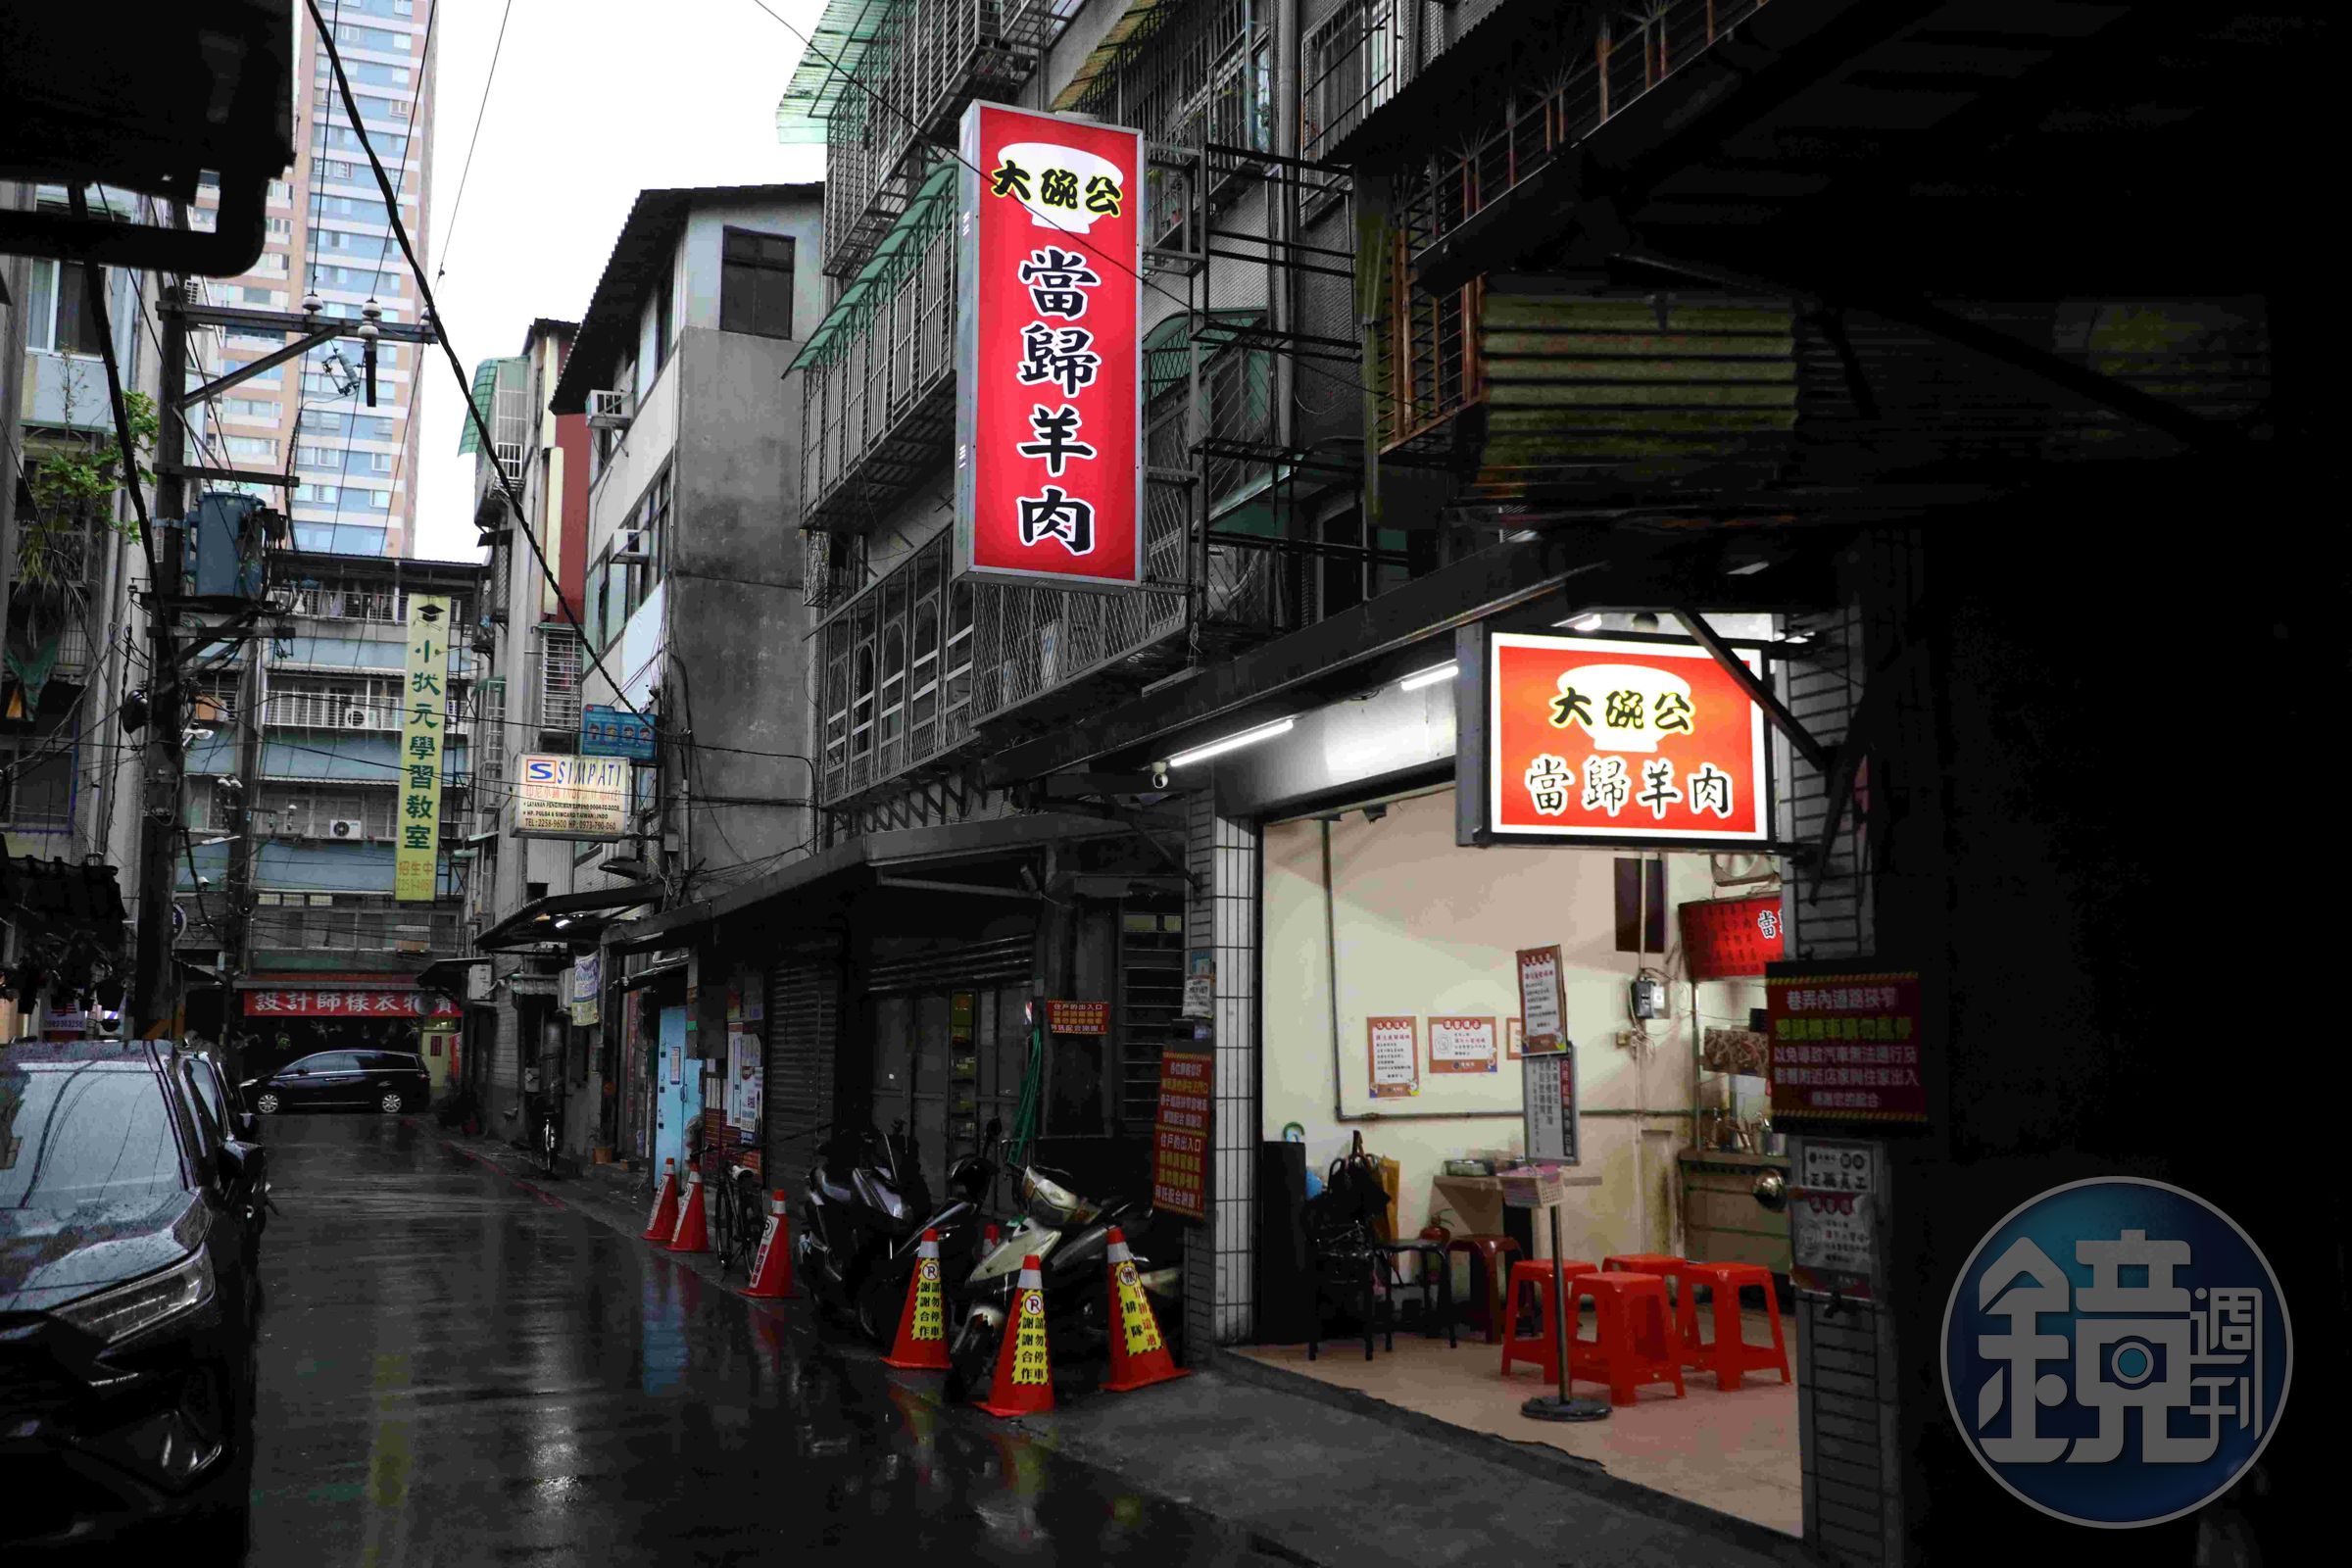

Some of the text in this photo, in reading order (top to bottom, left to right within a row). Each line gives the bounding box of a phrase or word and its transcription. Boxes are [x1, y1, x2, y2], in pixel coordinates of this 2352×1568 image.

[992, 159, 1123, 218] 大碗公
[1017, 246, 1102, 556] 當歸羊肉
[1548, 687, 1695, 734] 大碗公
[404, 640, 440, 850] 小狀元學習教室
[558, 761, 621, 786] SIMPATI
[1527, 754, 1732, 819] 當歸羊肉
[1758, 909, 1783, 939] 當
[1160, 1133, 1201, 1153] 住戶的出入口
[919, 1282, 930, 1337] 謝謝合作
[931, 1282, 941, 1337] 請勿停車
[1021, 1317, 1033, 1381] 謝謝合作
[1033, 1317, 1045, 1380] 請勿停車
